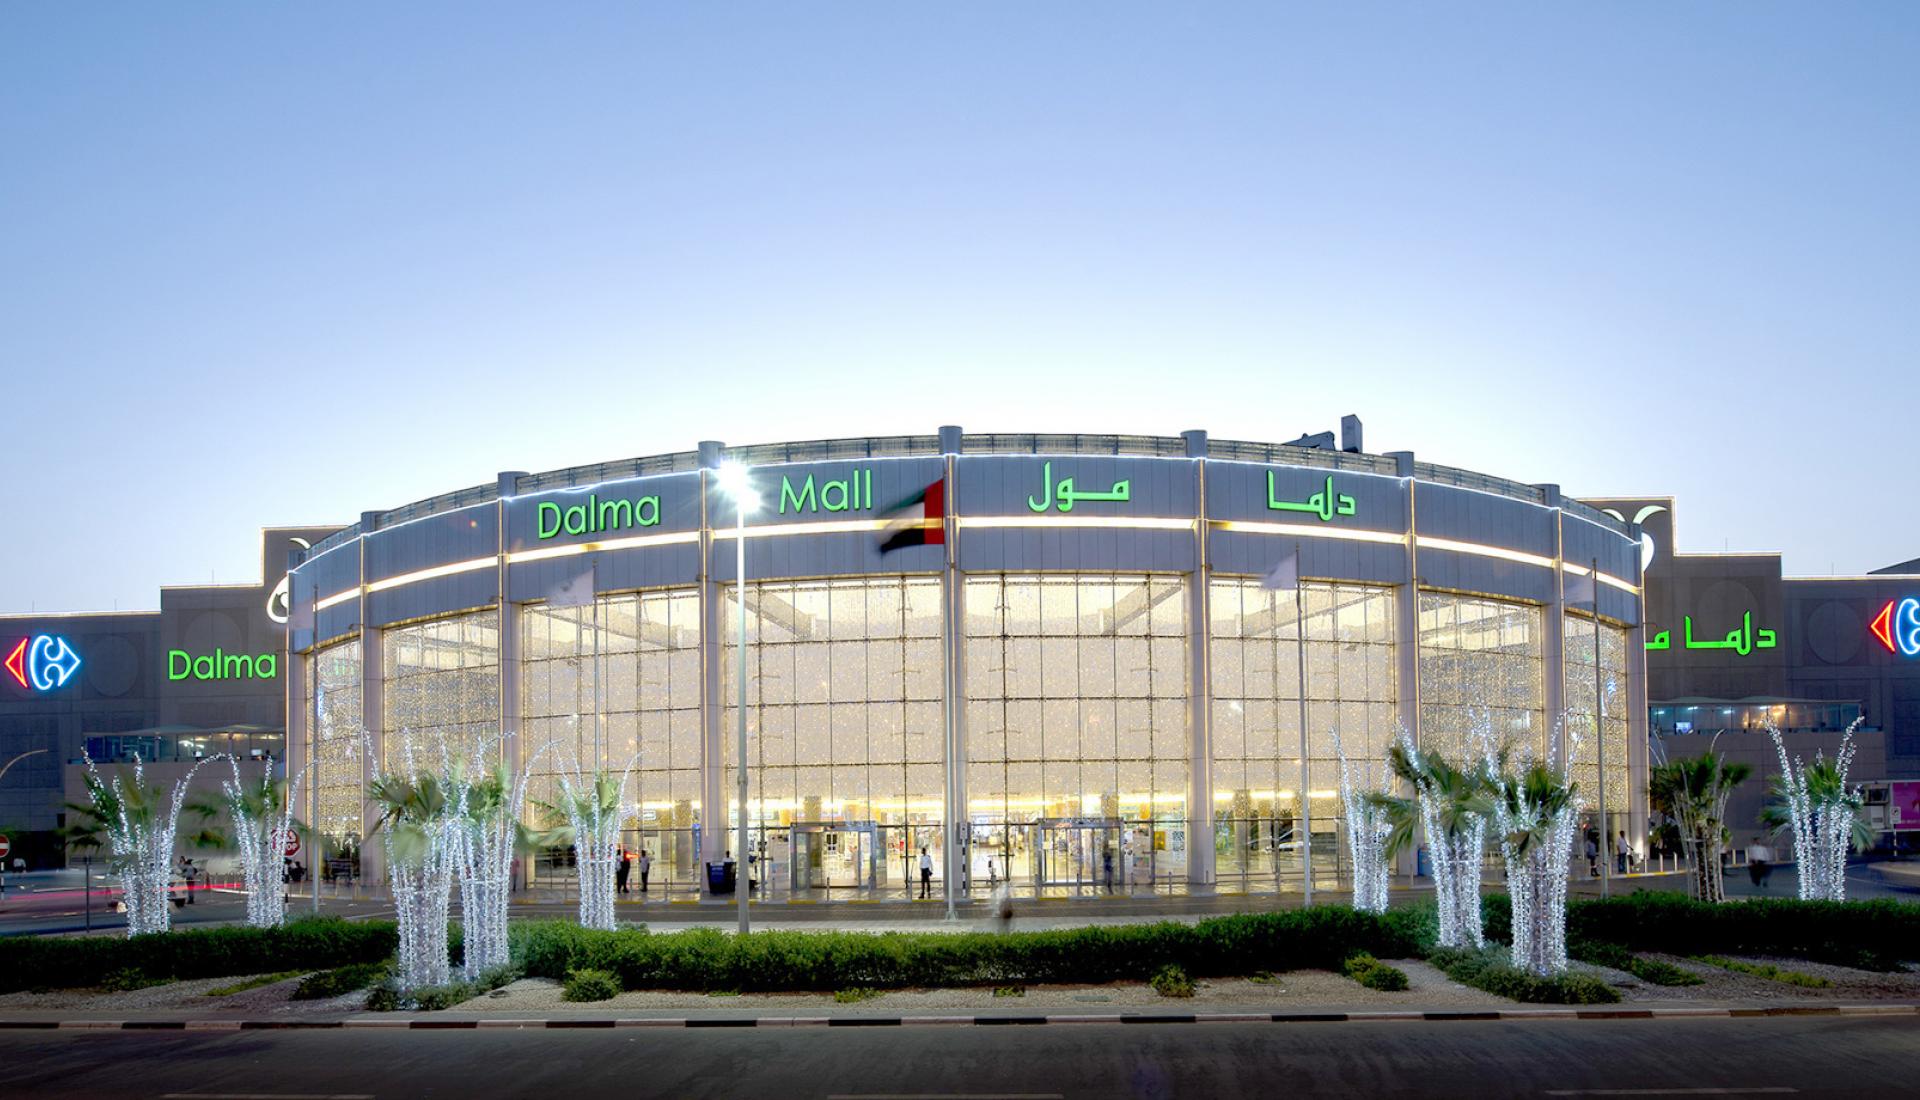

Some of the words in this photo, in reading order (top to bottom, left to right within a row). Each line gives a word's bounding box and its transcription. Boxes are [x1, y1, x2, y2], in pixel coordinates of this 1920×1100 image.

[537, 495, 661, 539] Dalma
[779, 468, 873, 514] Mall
[1028, 460, 1131, 513] مول
[1266, 470, 1357, 522] دلما
[1684, 610, 1777, 656] دلما
[168, 647, 277, 681] Dalma
